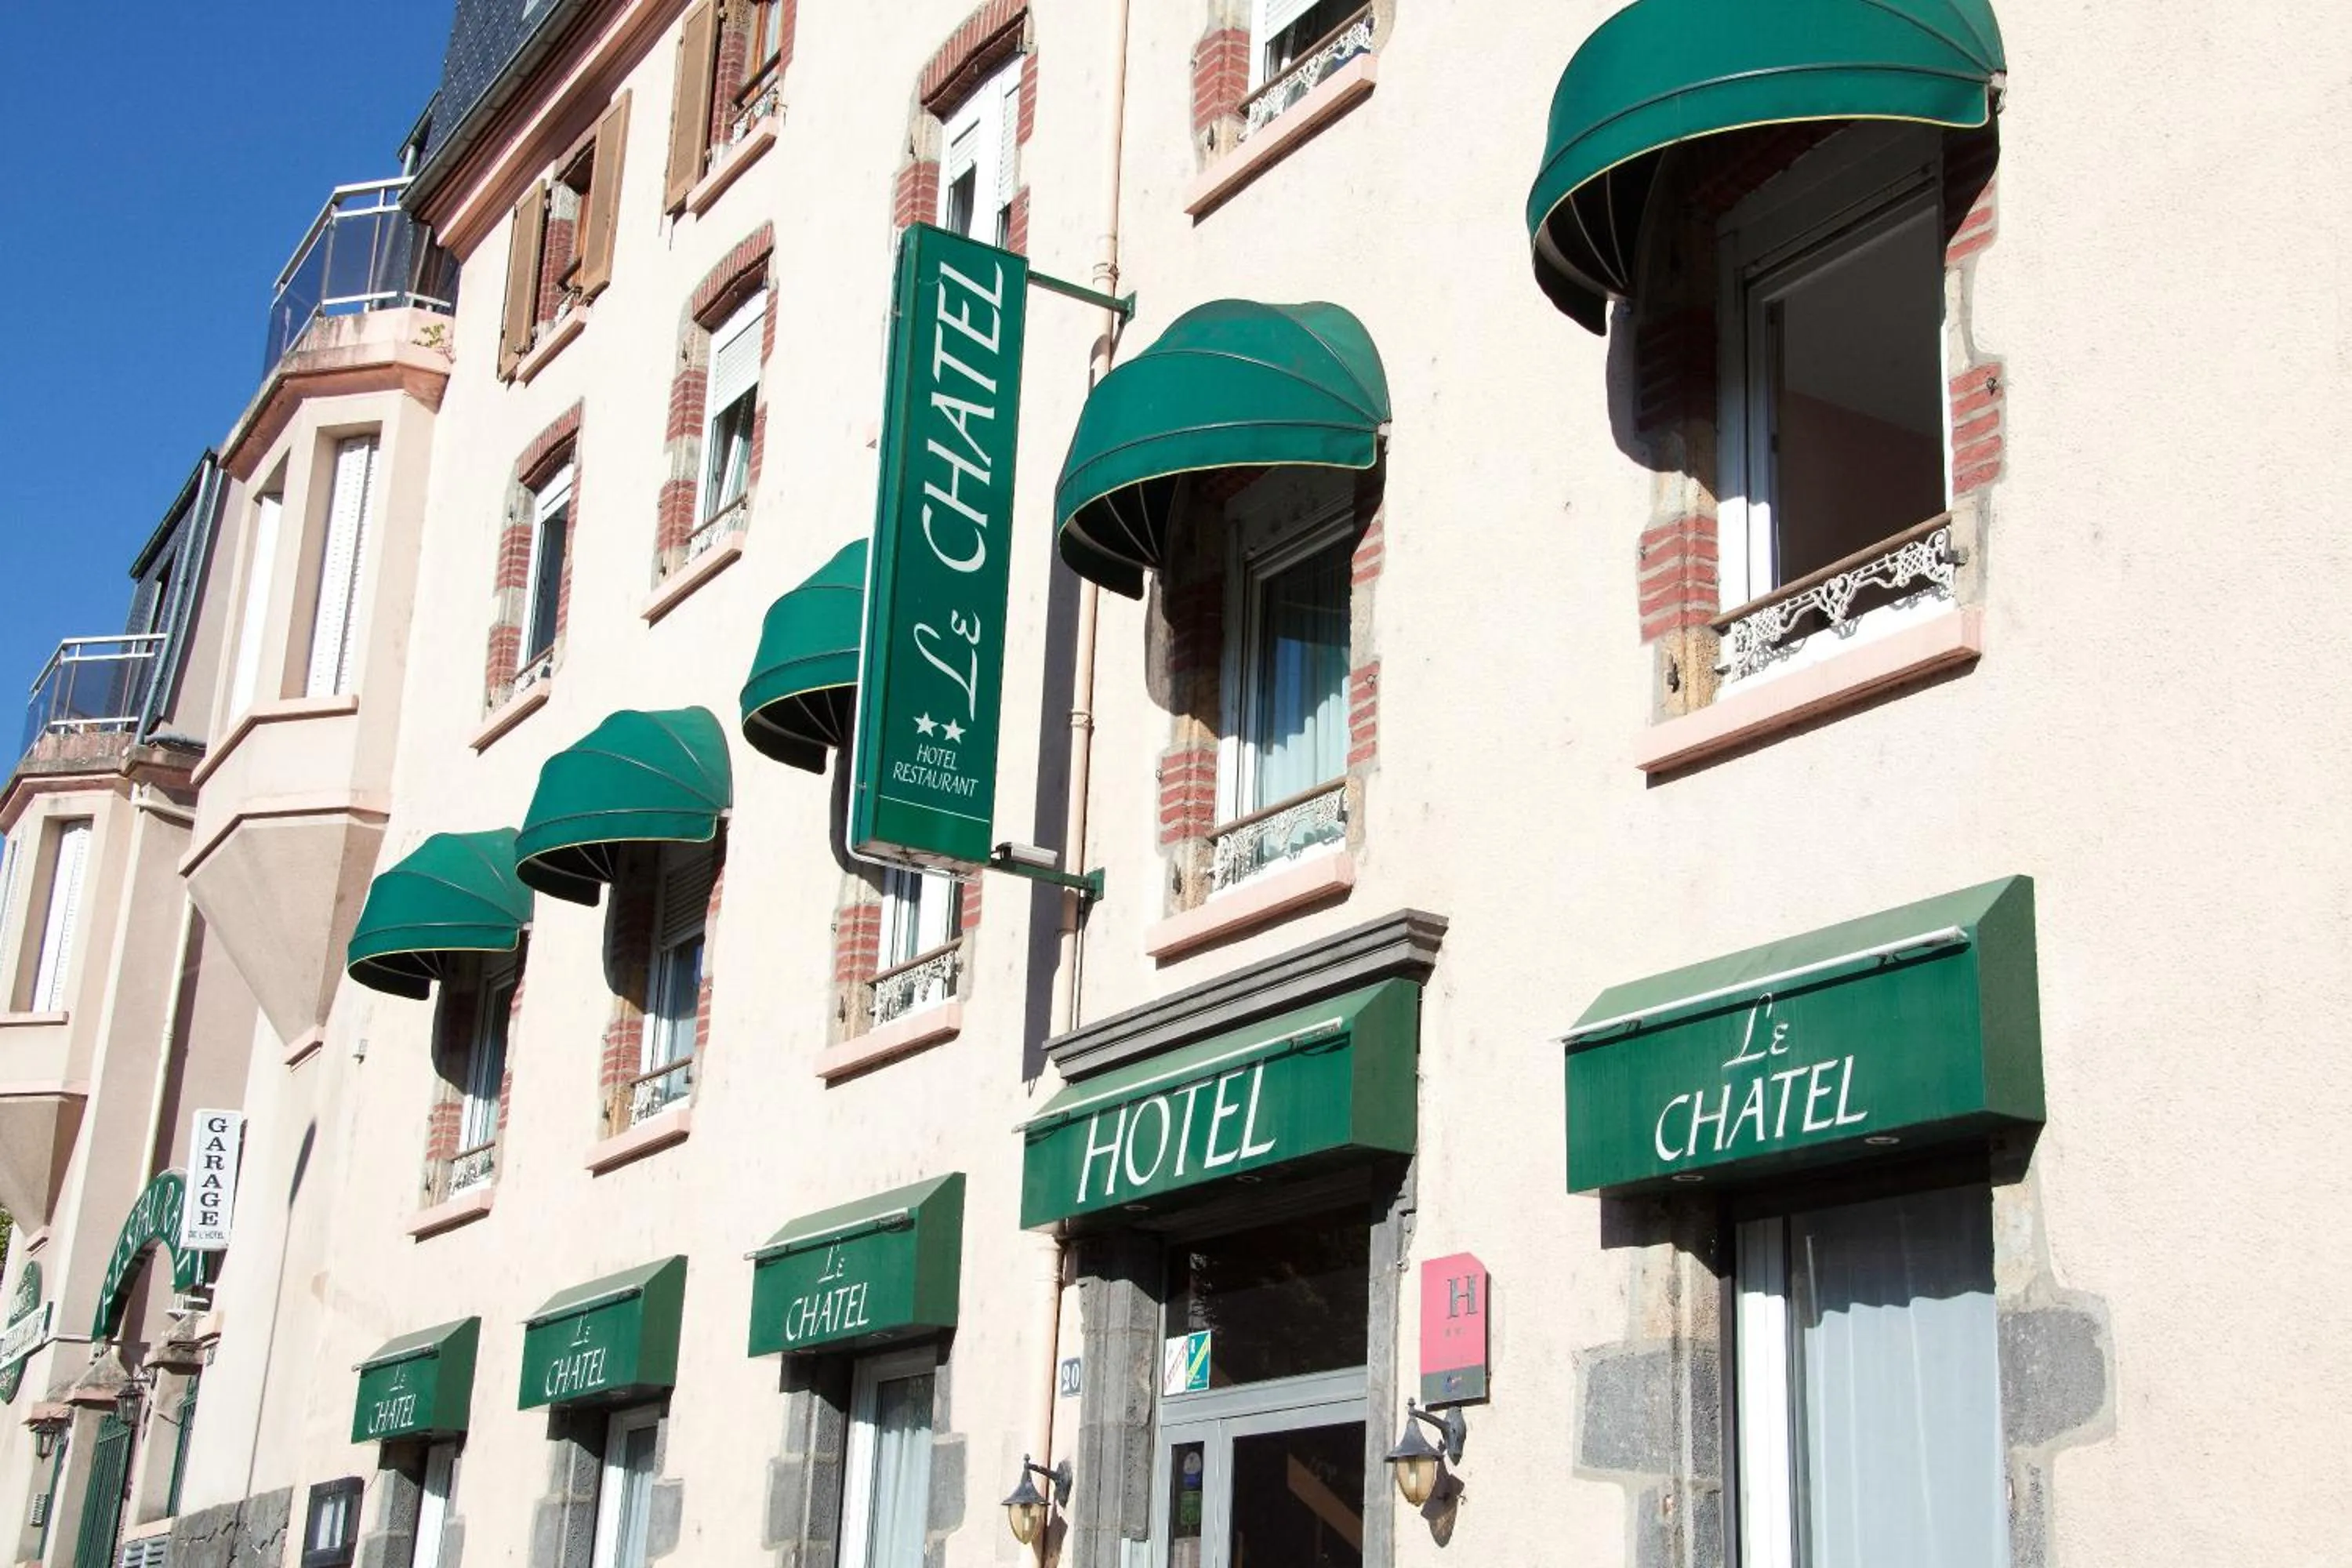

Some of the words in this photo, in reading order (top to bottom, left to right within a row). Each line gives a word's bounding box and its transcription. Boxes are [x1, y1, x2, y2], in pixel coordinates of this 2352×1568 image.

[921, 260, 1004, 573] CHATEL
[893, 760, 979, 798] RESTAURANT
[916, 742, 956, 771] HOTEL
[1077, 1058, 1277, 1204] HOTEL
[1655, 1054, 1869, 1162] CHATEL
[198, 1117, 229, 1227] GARAGE
[786, 1282, 869, 1341] CHATEL
[1446, 1273, 1479, 1319] H
[545, 1347, 607, 1397] CHATEL
[368, 1392, 417, 1435] CHATEL
